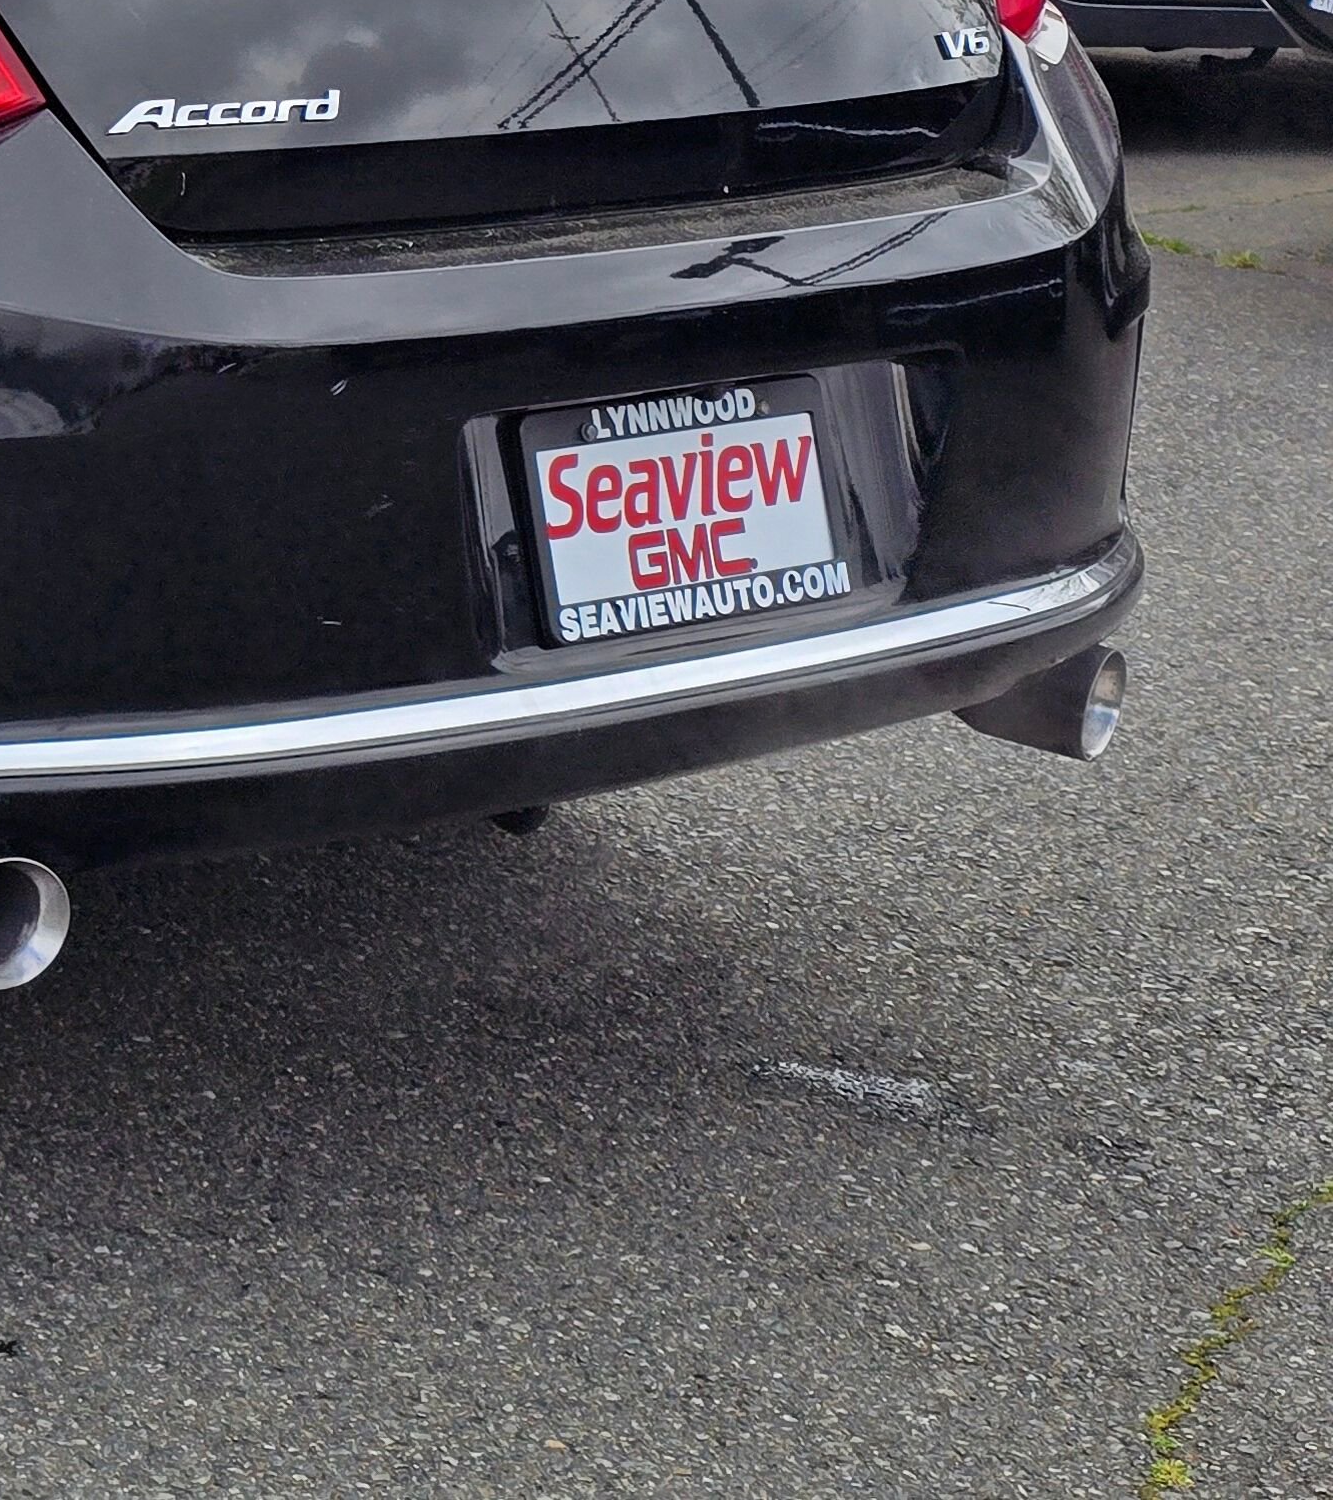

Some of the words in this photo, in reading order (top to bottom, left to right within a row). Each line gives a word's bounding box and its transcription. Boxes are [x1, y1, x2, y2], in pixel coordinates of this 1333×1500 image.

[934, 26, 990, 60] V6
[106, 89, 340, 135] Accord
[590, 388, 756, 439] LYNNWOOD
[545, 432, 812, 540] Seaview
[628, 517, 758, 591] GMC
[559, 561, 851, 643] SEAVIEWAUTO.COM
